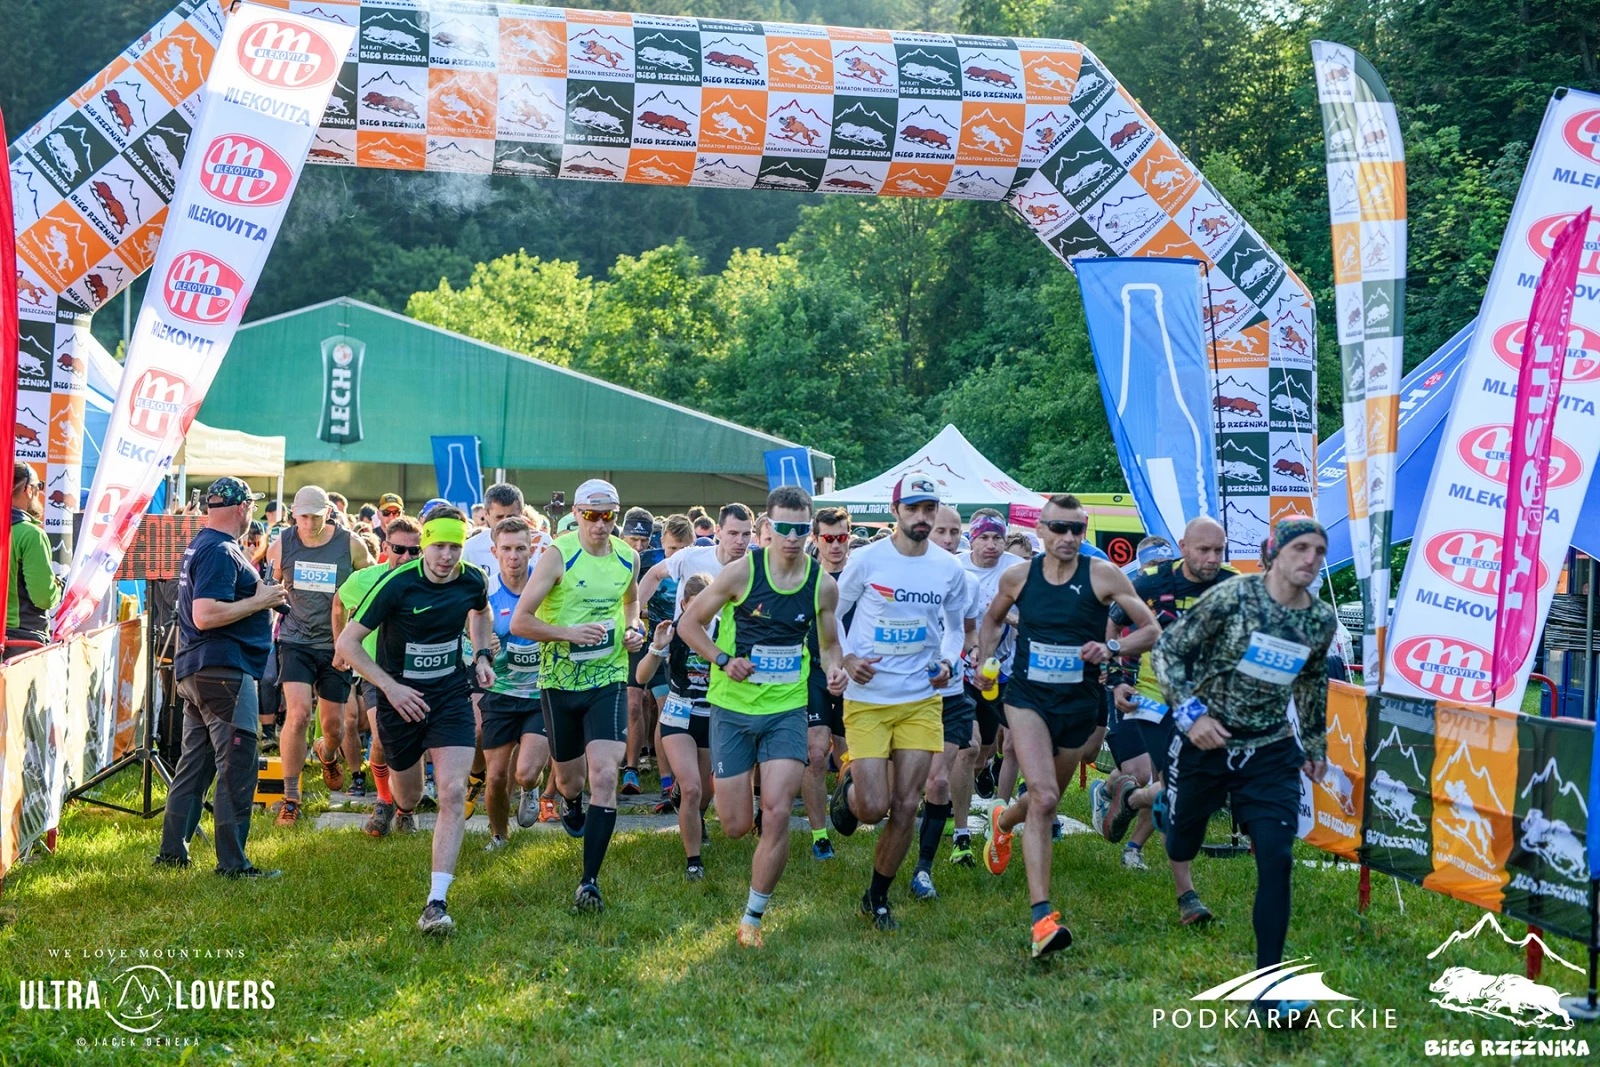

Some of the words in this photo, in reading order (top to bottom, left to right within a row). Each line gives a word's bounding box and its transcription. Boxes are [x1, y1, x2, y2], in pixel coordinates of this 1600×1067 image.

[300, 570, 329, 581] 5052
[894, 588, 942, 605] Gmoto
[883, 628, 918, 641] 5157
[413, 654, 449, 668] 6091
[759, 655, 794, 669] 5382
[1037, 656, 1075, 670] 5073
[1254, 649, 1297, 670] 5335
[1424, 664, 1480, 678] MLEKOVITA
